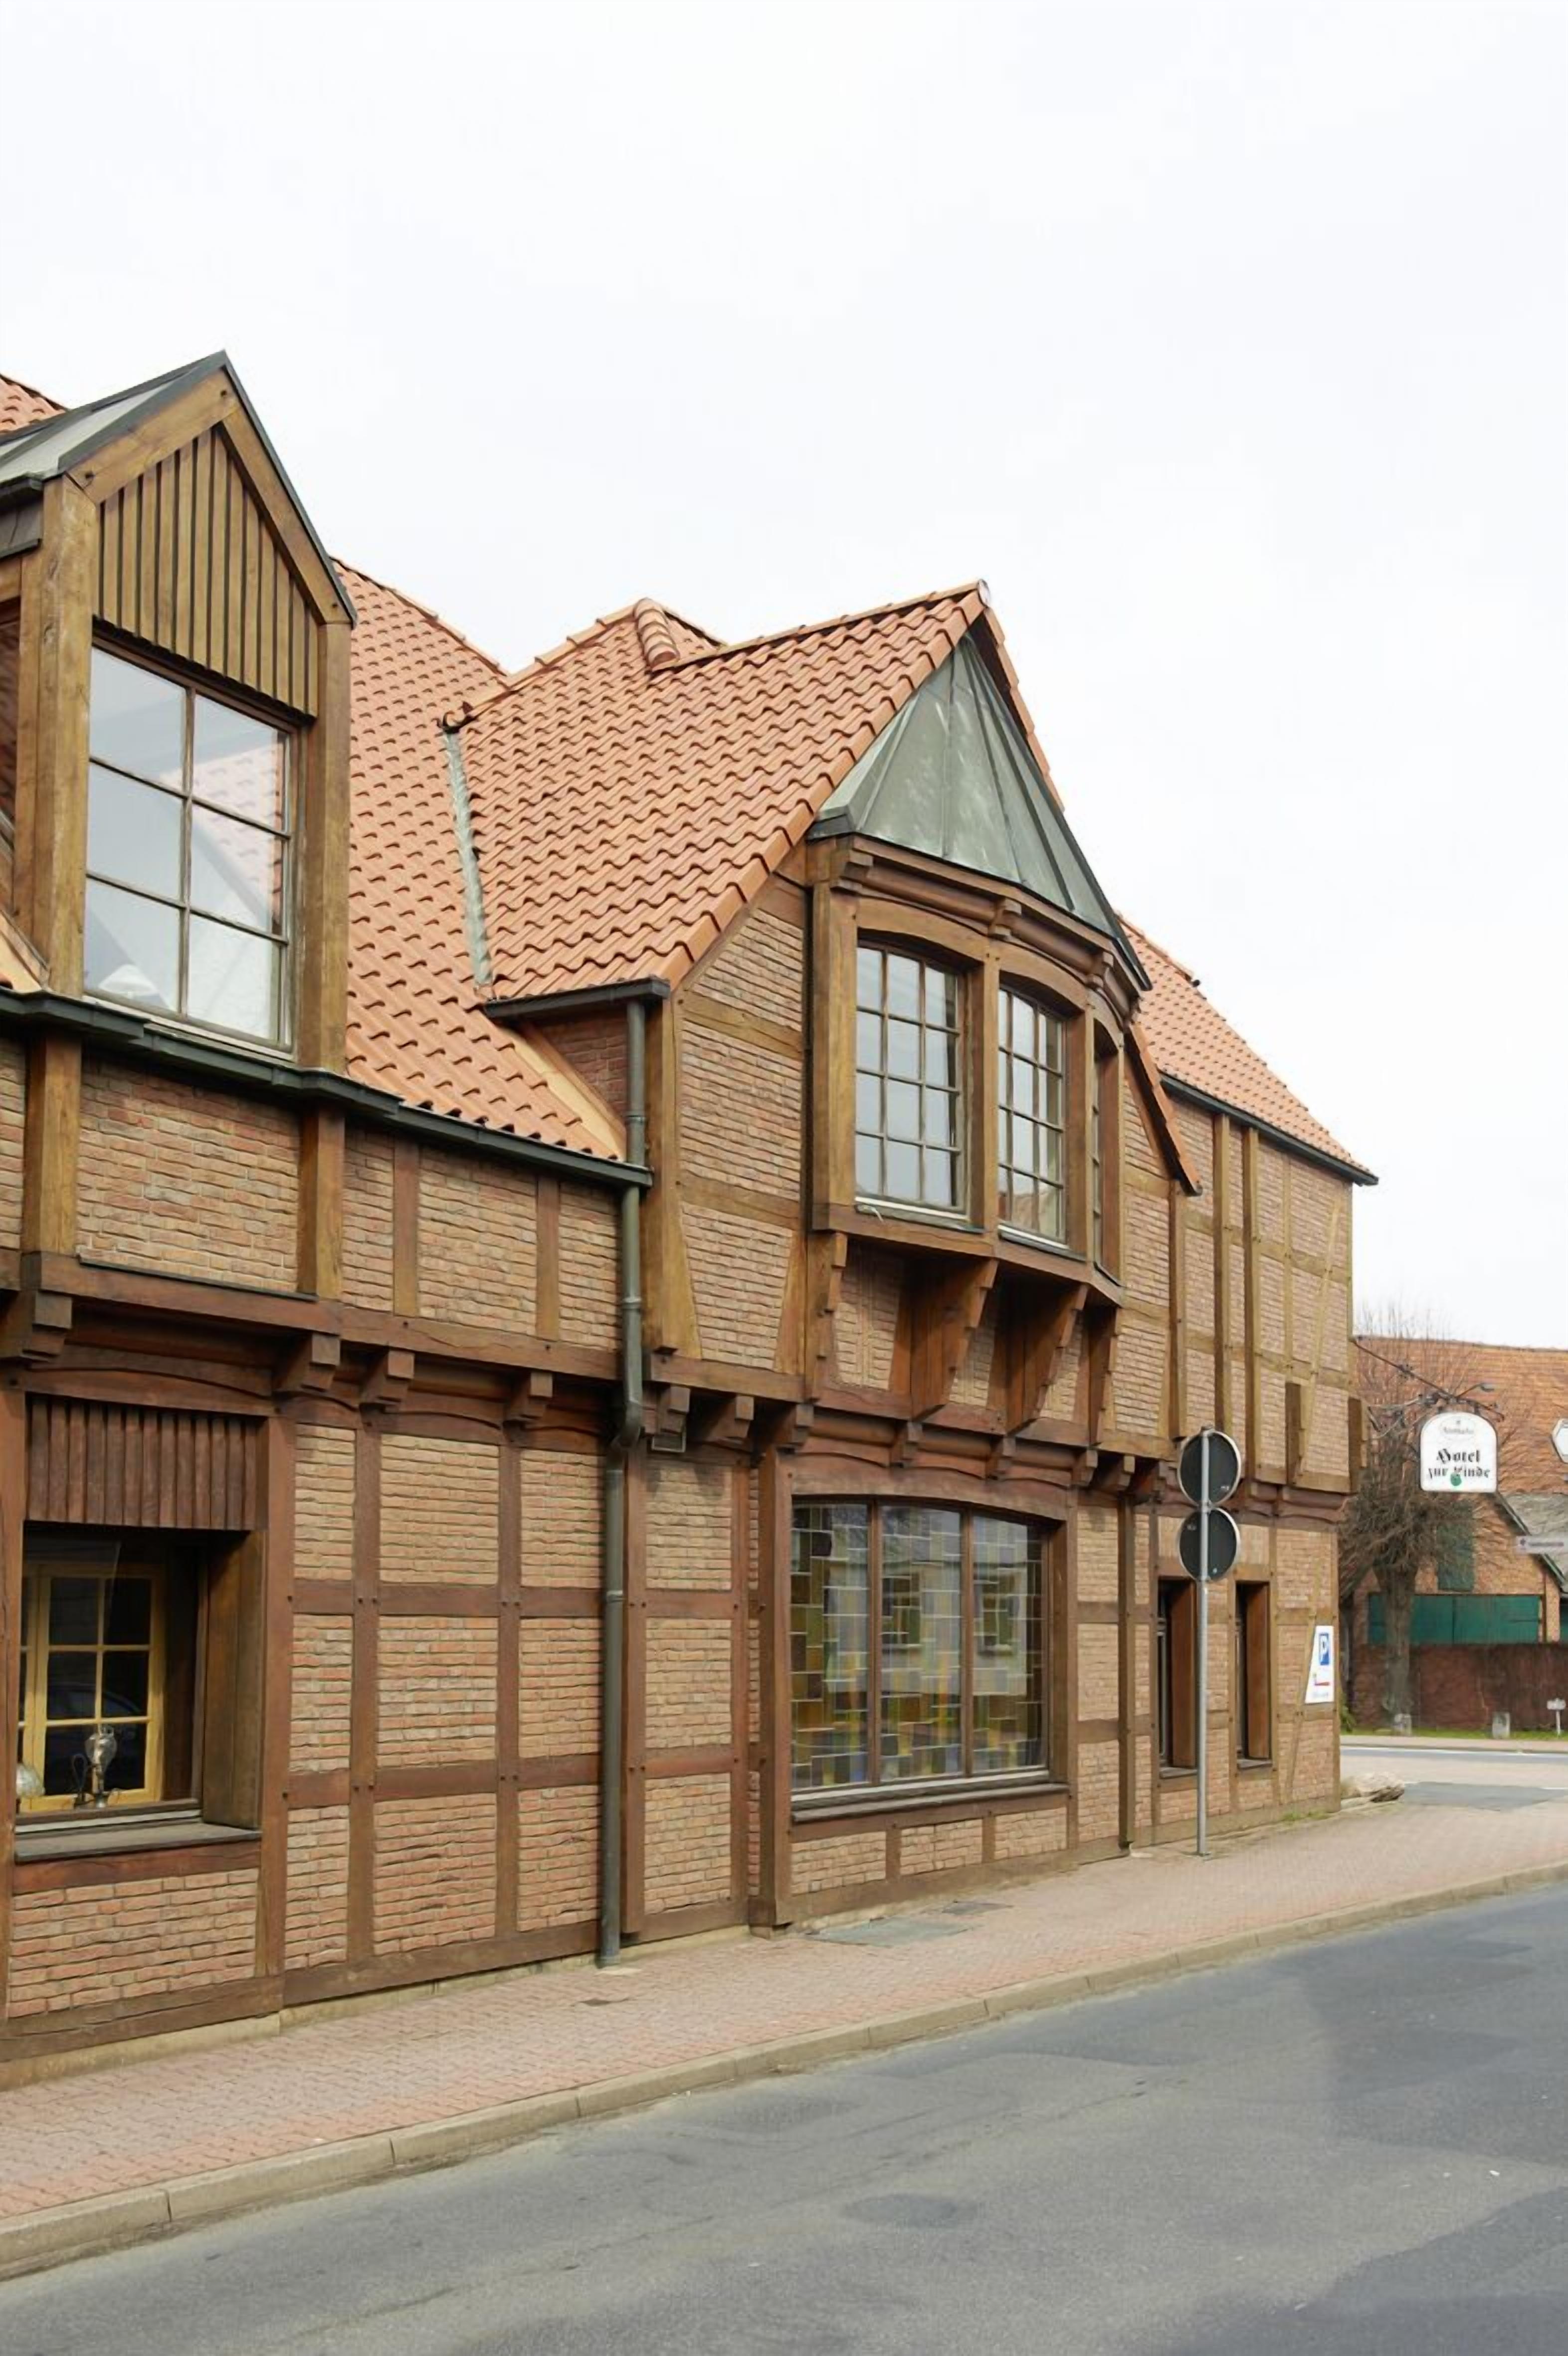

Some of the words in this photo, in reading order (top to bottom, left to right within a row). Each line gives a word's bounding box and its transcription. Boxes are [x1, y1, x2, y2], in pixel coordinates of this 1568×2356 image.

[1437, 1448, 1480, 1464] Hotel
[1428, 1468, 1448, 1479] zur
[1320, 1635, 1328, 1662] P
